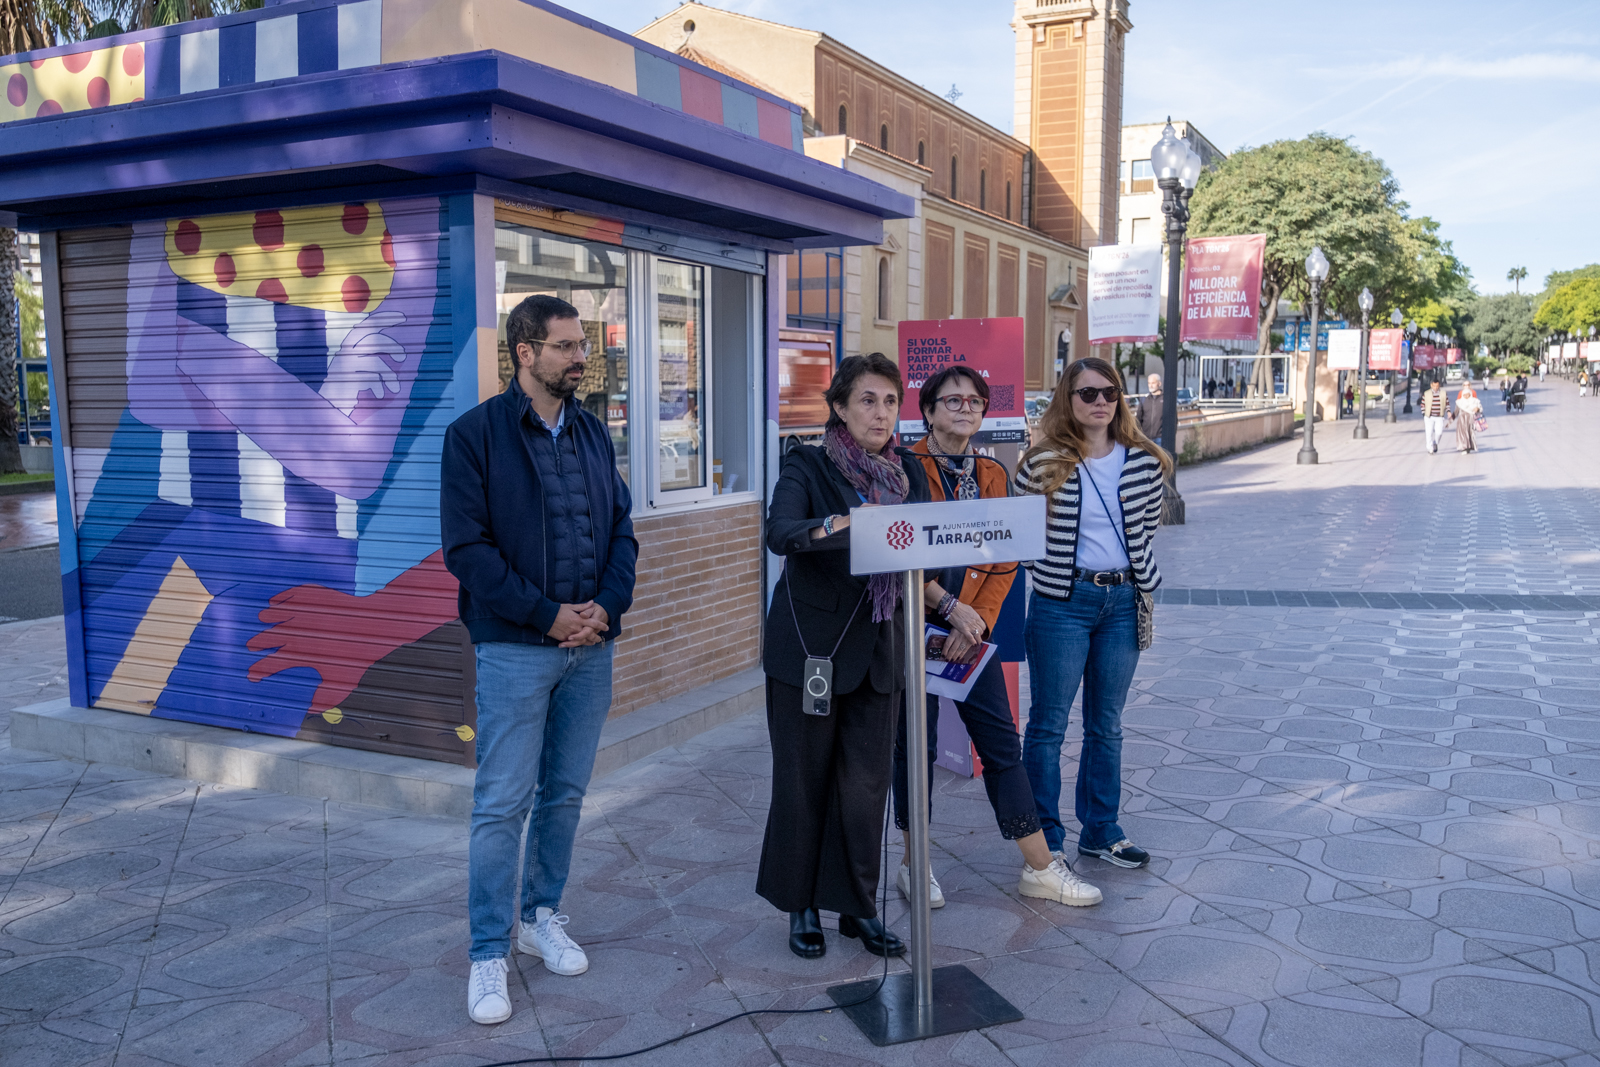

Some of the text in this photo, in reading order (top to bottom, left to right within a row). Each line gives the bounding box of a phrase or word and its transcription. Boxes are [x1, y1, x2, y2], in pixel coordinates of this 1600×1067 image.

[1115, 269, 1138, 277] posant
[1123, 283, 1152, 291] recollida
[1189, 276, 1237, 290] MILLORAR
[1102, 292, 1125, 300] residus
[1129, 291, 1153, 299] neteja.
[1188, 289, 1246, 305] L'EFICIÈNCIA
[1187, 305, 1252, 320] DE LA NETEJA.
[920, 338, 947, 346] VOLS
[907, 346, 952, 355] FORMAR
[907, 355, 934, 363] PART
[953, 354, 966, 362] LA
[908, 363, 946, 371] XARXA
[942, 521, 991, 530] AJUNTAMENT
